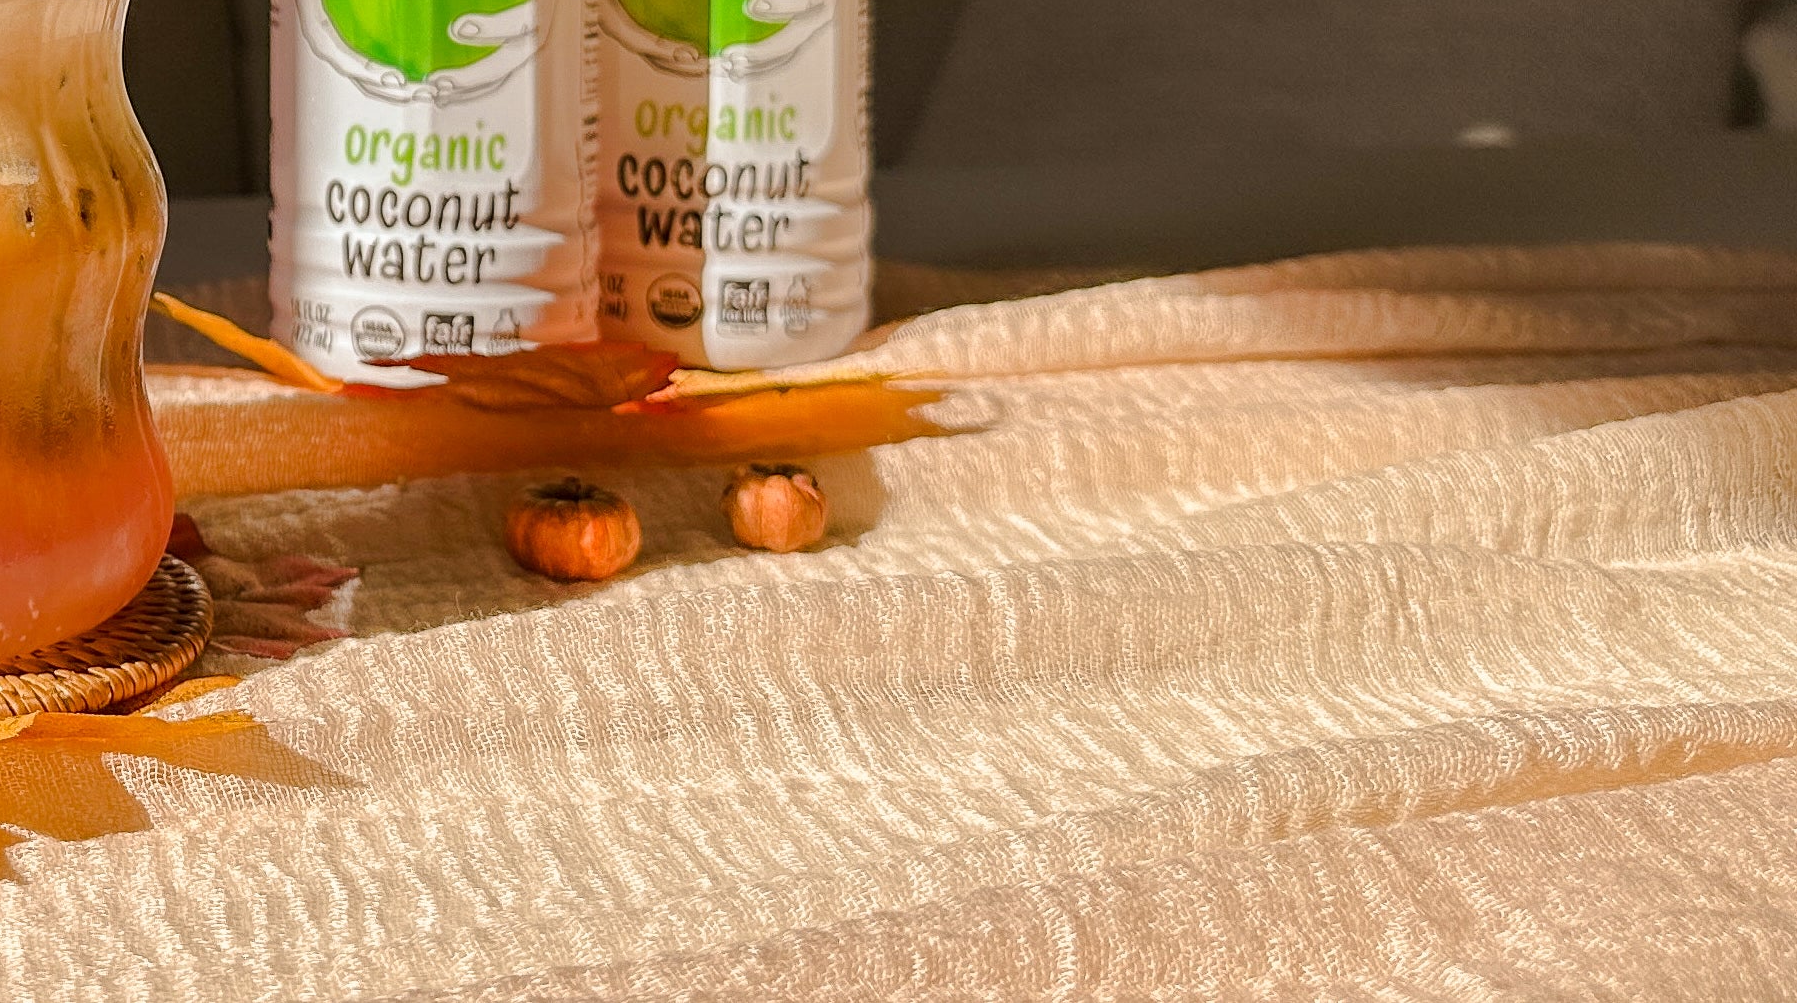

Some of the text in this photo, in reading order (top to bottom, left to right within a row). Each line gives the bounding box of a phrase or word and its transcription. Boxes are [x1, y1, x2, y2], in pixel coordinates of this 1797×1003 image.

[635, 93, 798, 158] organic
[345, 119, 507, 187] organic
[617, 147, 810, 201] coconut
[325, 178, 520, 232] coconut
[638, 203, 791, 253] water
[341, 231, 496, 285] water
